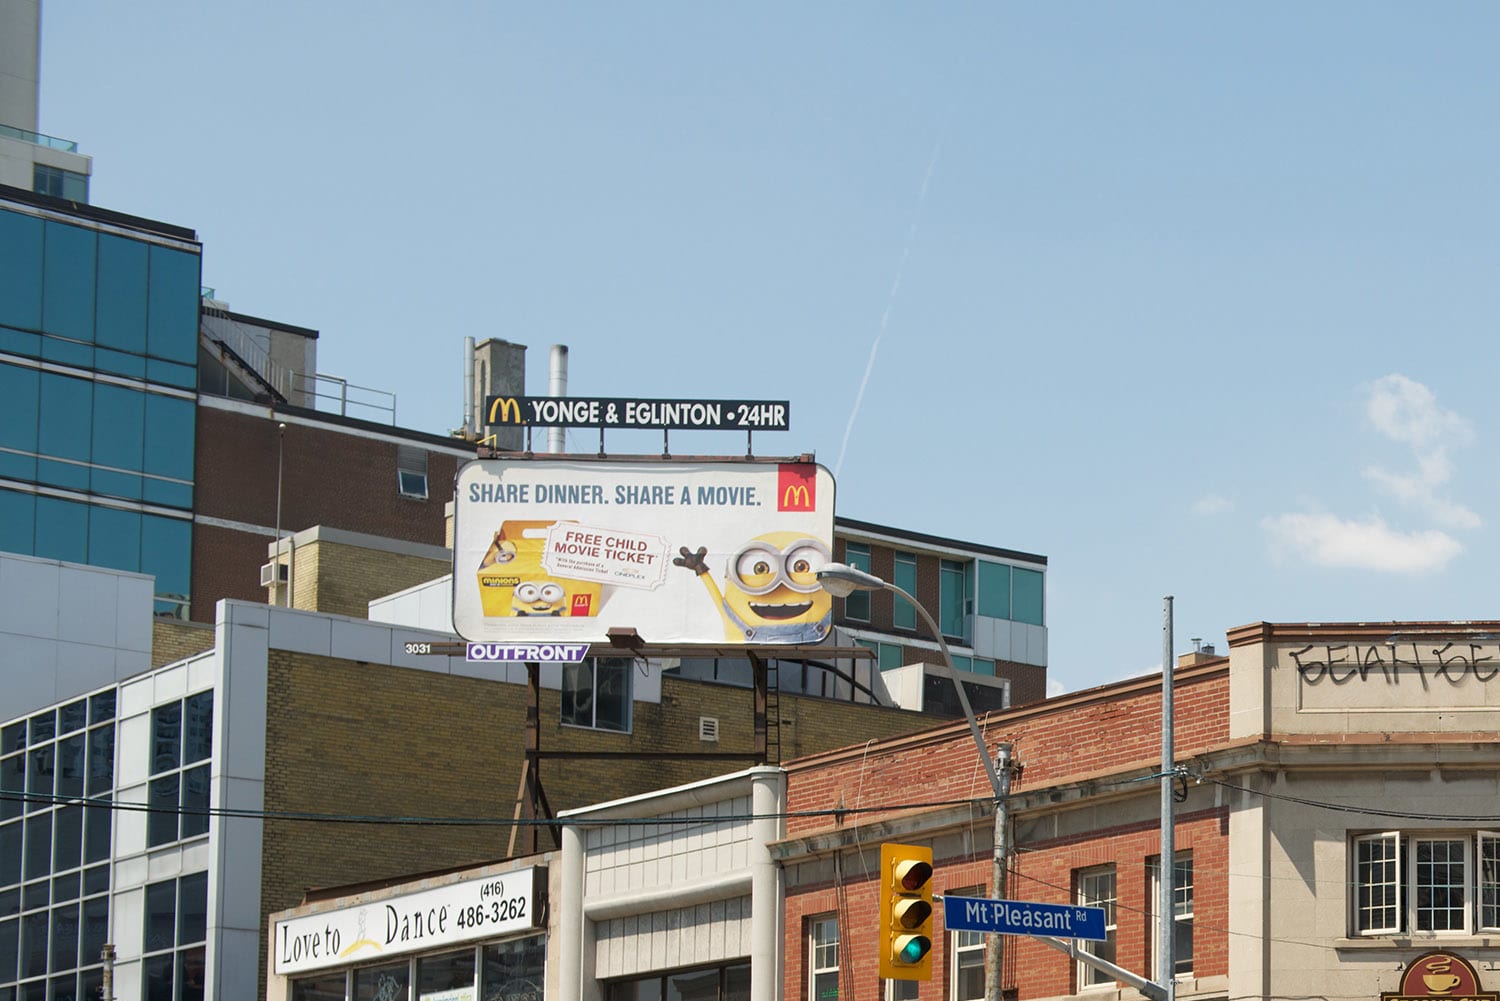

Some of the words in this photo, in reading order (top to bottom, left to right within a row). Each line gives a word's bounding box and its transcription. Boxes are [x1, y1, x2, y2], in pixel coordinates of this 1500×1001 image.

[531, 400, 599, 424] YONGE
[605, 403, 619, 423] &
[625, 402, 720, 426] EGLINTON
[738, 404, 785, 427] 24HR
[469, 483, 529, 503] SHARE
[535, 484, 609, 505] DINNER.
[615, 484, 674, 505] SHARE
[680, 486, 692, 505] A
[697, 486, 762, 506] MOVIE.
[554, 542, 600, 557] MOVIE
[565, 531, 602, 545] FREE
[605, 536, 647, 551] CHILD
[405, 643, 431, 654] 3031
[471, 645, 582, 661] OUTFRONT
[480, 880, 505, 902] (416)
[965, 901, 988, 924] Mt
[993, 903, 1072, 930] Pleasant
[1075, 910, 1087, 922] Rd
[282, 924, 321, 964] Love
[325, 923, 341, 956] to
[385, 904, 448, 945] Dance
[457, 896, 527, 930] 486-3262
